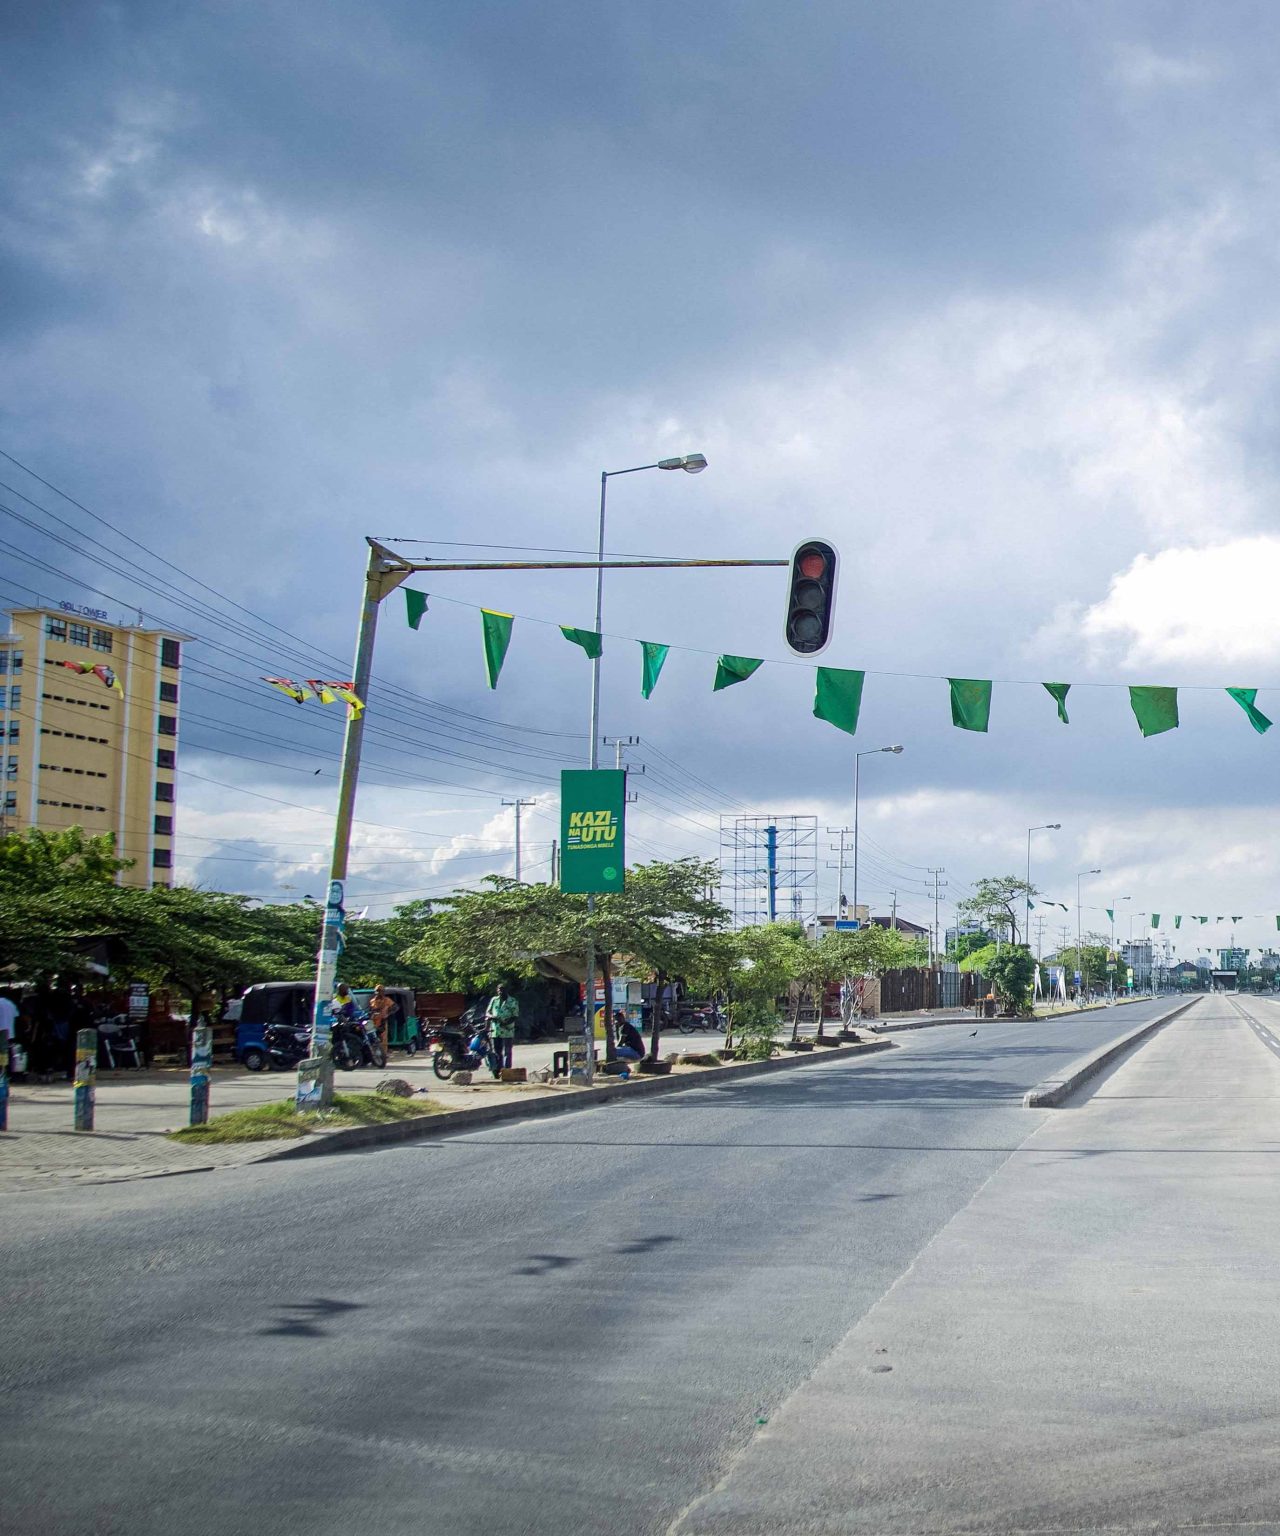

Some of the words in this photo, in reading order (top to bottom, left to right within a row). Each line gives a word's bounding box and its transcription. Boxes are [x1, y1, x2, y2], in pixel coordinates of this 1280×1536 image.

[78, 604, 108, 619] TOWER
[570, 811, 611, 827] KAZI
[582, 826, 616, 842] UTU
